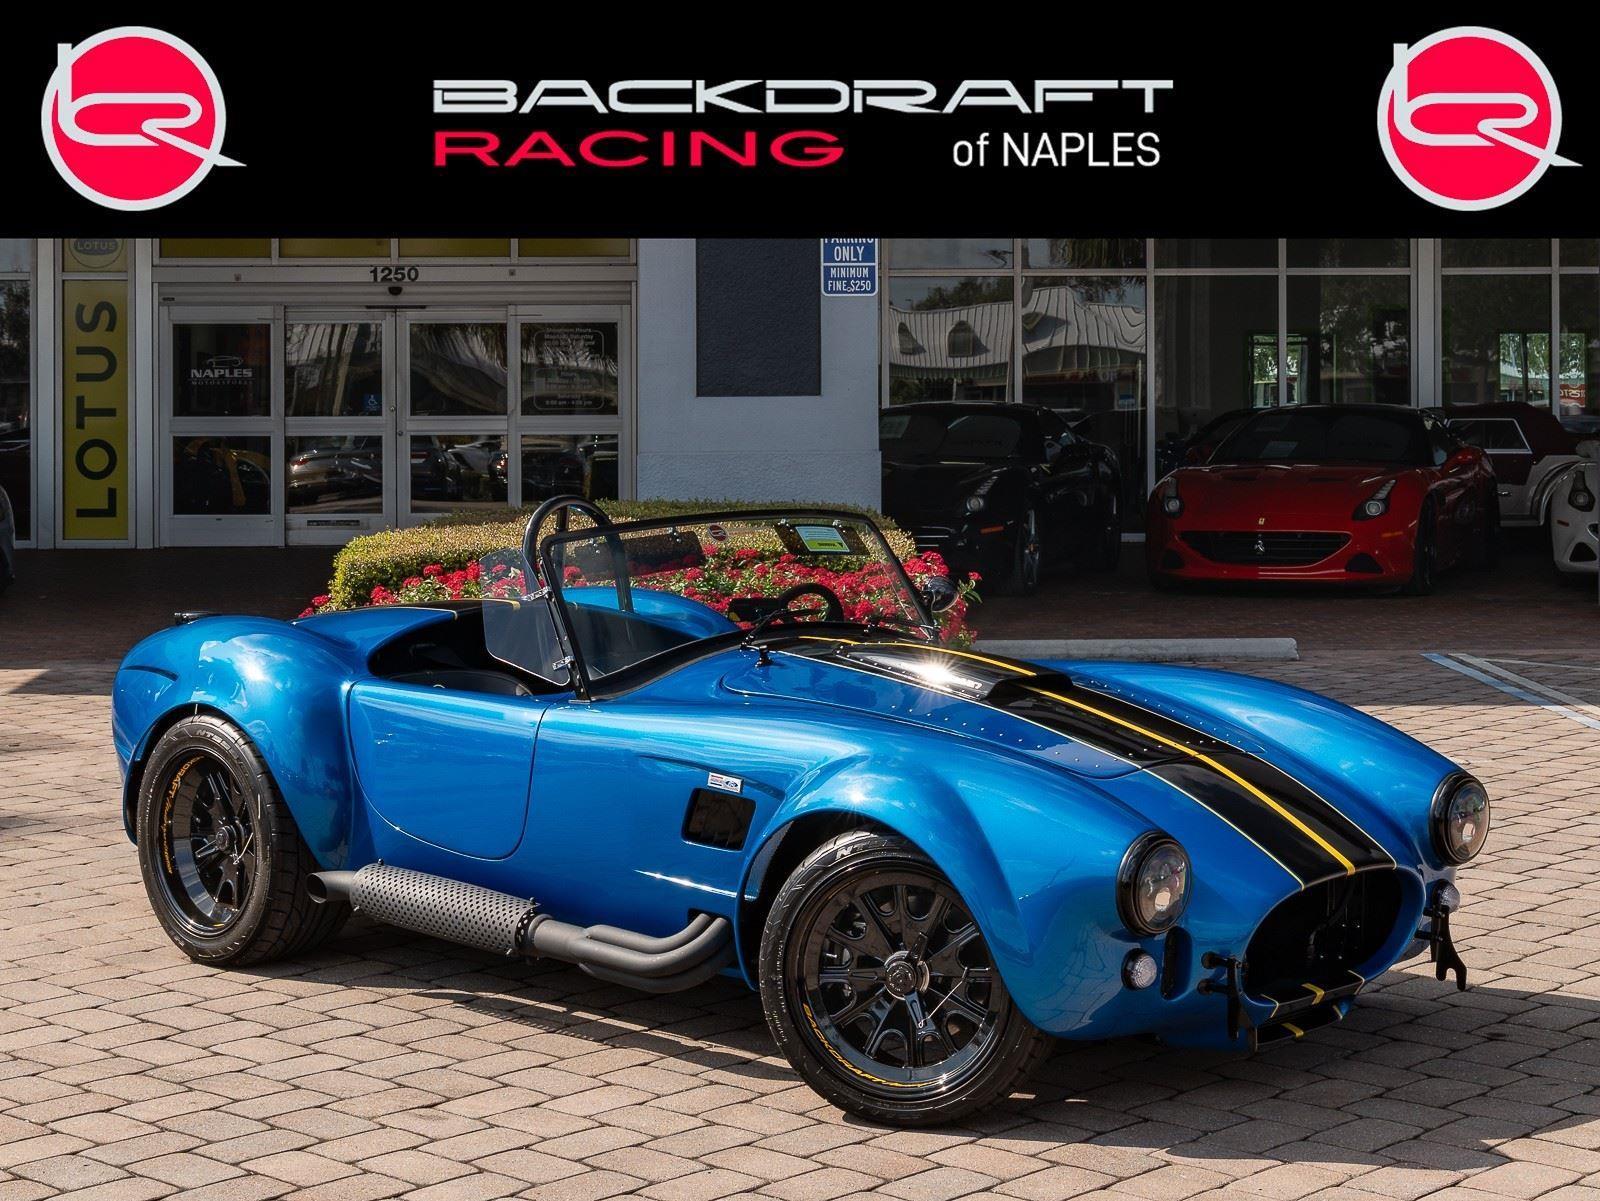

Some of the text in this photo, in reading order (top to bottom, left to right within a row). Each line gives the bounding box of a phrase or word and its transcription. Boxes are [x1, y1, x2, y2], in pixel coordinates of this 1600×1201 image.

[76, 239, 117, 250] LOTUS
[834, 245, 865, 262] ONLY
[370, 265, 419, 282] 1250
[830, 267, 869, 278] MINIMUM
[828, 279, 871, 292] FINE $250
[190, 368, 253, 378] NAPLES
[75, 300, 118, 518] LOTUS
